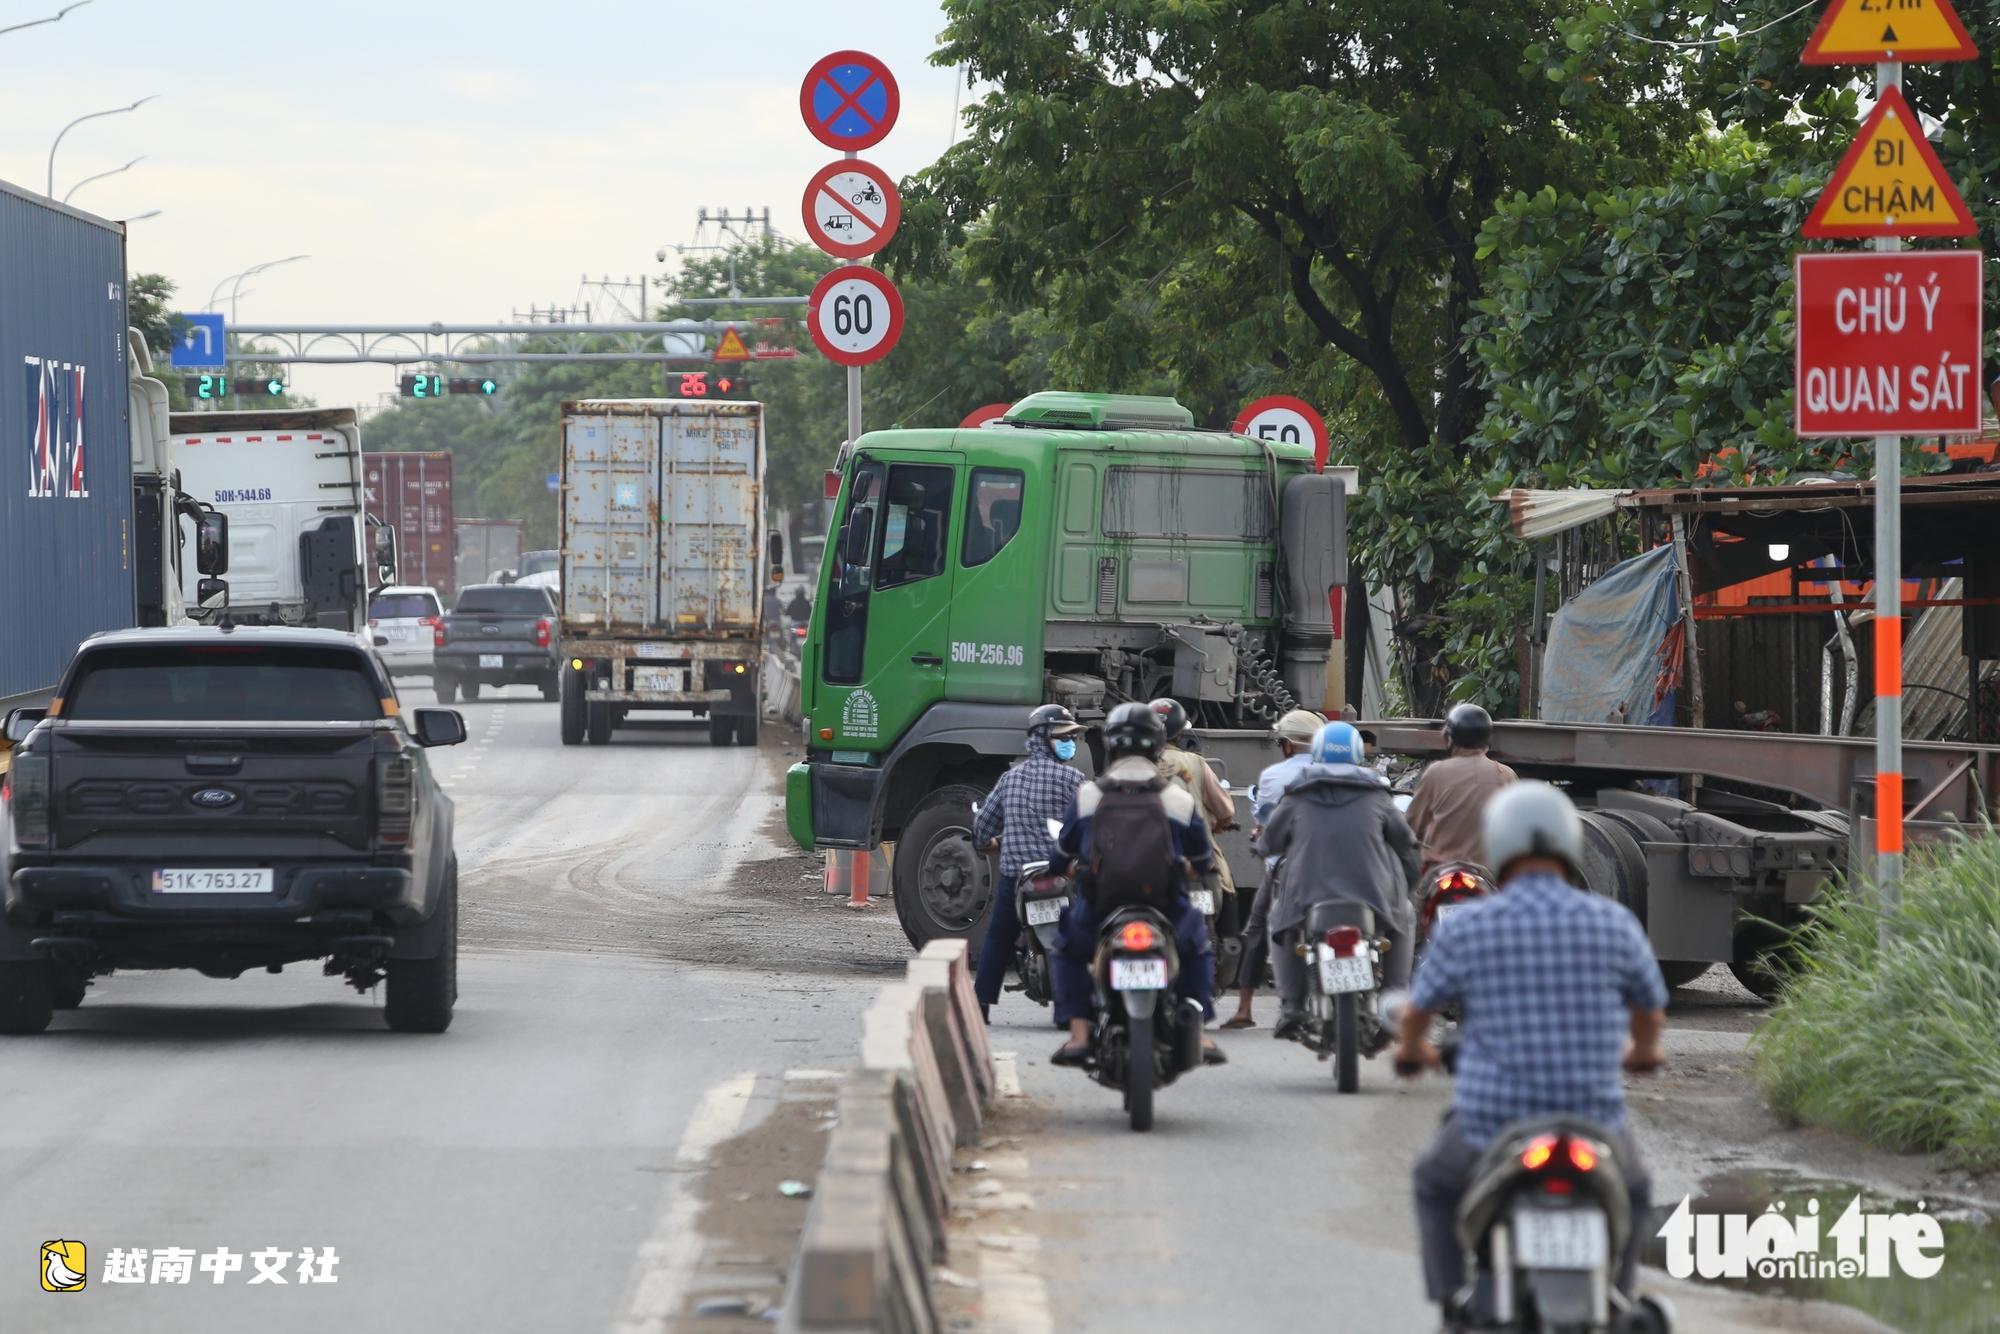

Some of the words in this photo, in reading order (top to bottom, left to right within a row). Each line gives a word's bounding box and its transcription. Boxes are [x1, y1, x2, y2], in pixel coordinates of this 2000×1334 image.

[1874, 139, 1904, 166] ĐI
[1843, 179, 1934, 218] CHẬM
[1919, 272, 1941, 332] Ý
[834, 294, 873, 336] 60
[198, 375, 226, 398] 21
[413, 375, 441, 398] 21
[680, 373, 706, 396] 26
[1806, 364, 1900, 414] QUAN
[1909, 351, 1970, 410] SÁT
[951, 641, 1024, 666] 50H-256.96
[201, 791, 225, 802] Ford
[163, 873, 263, 889] 51K-763.27
